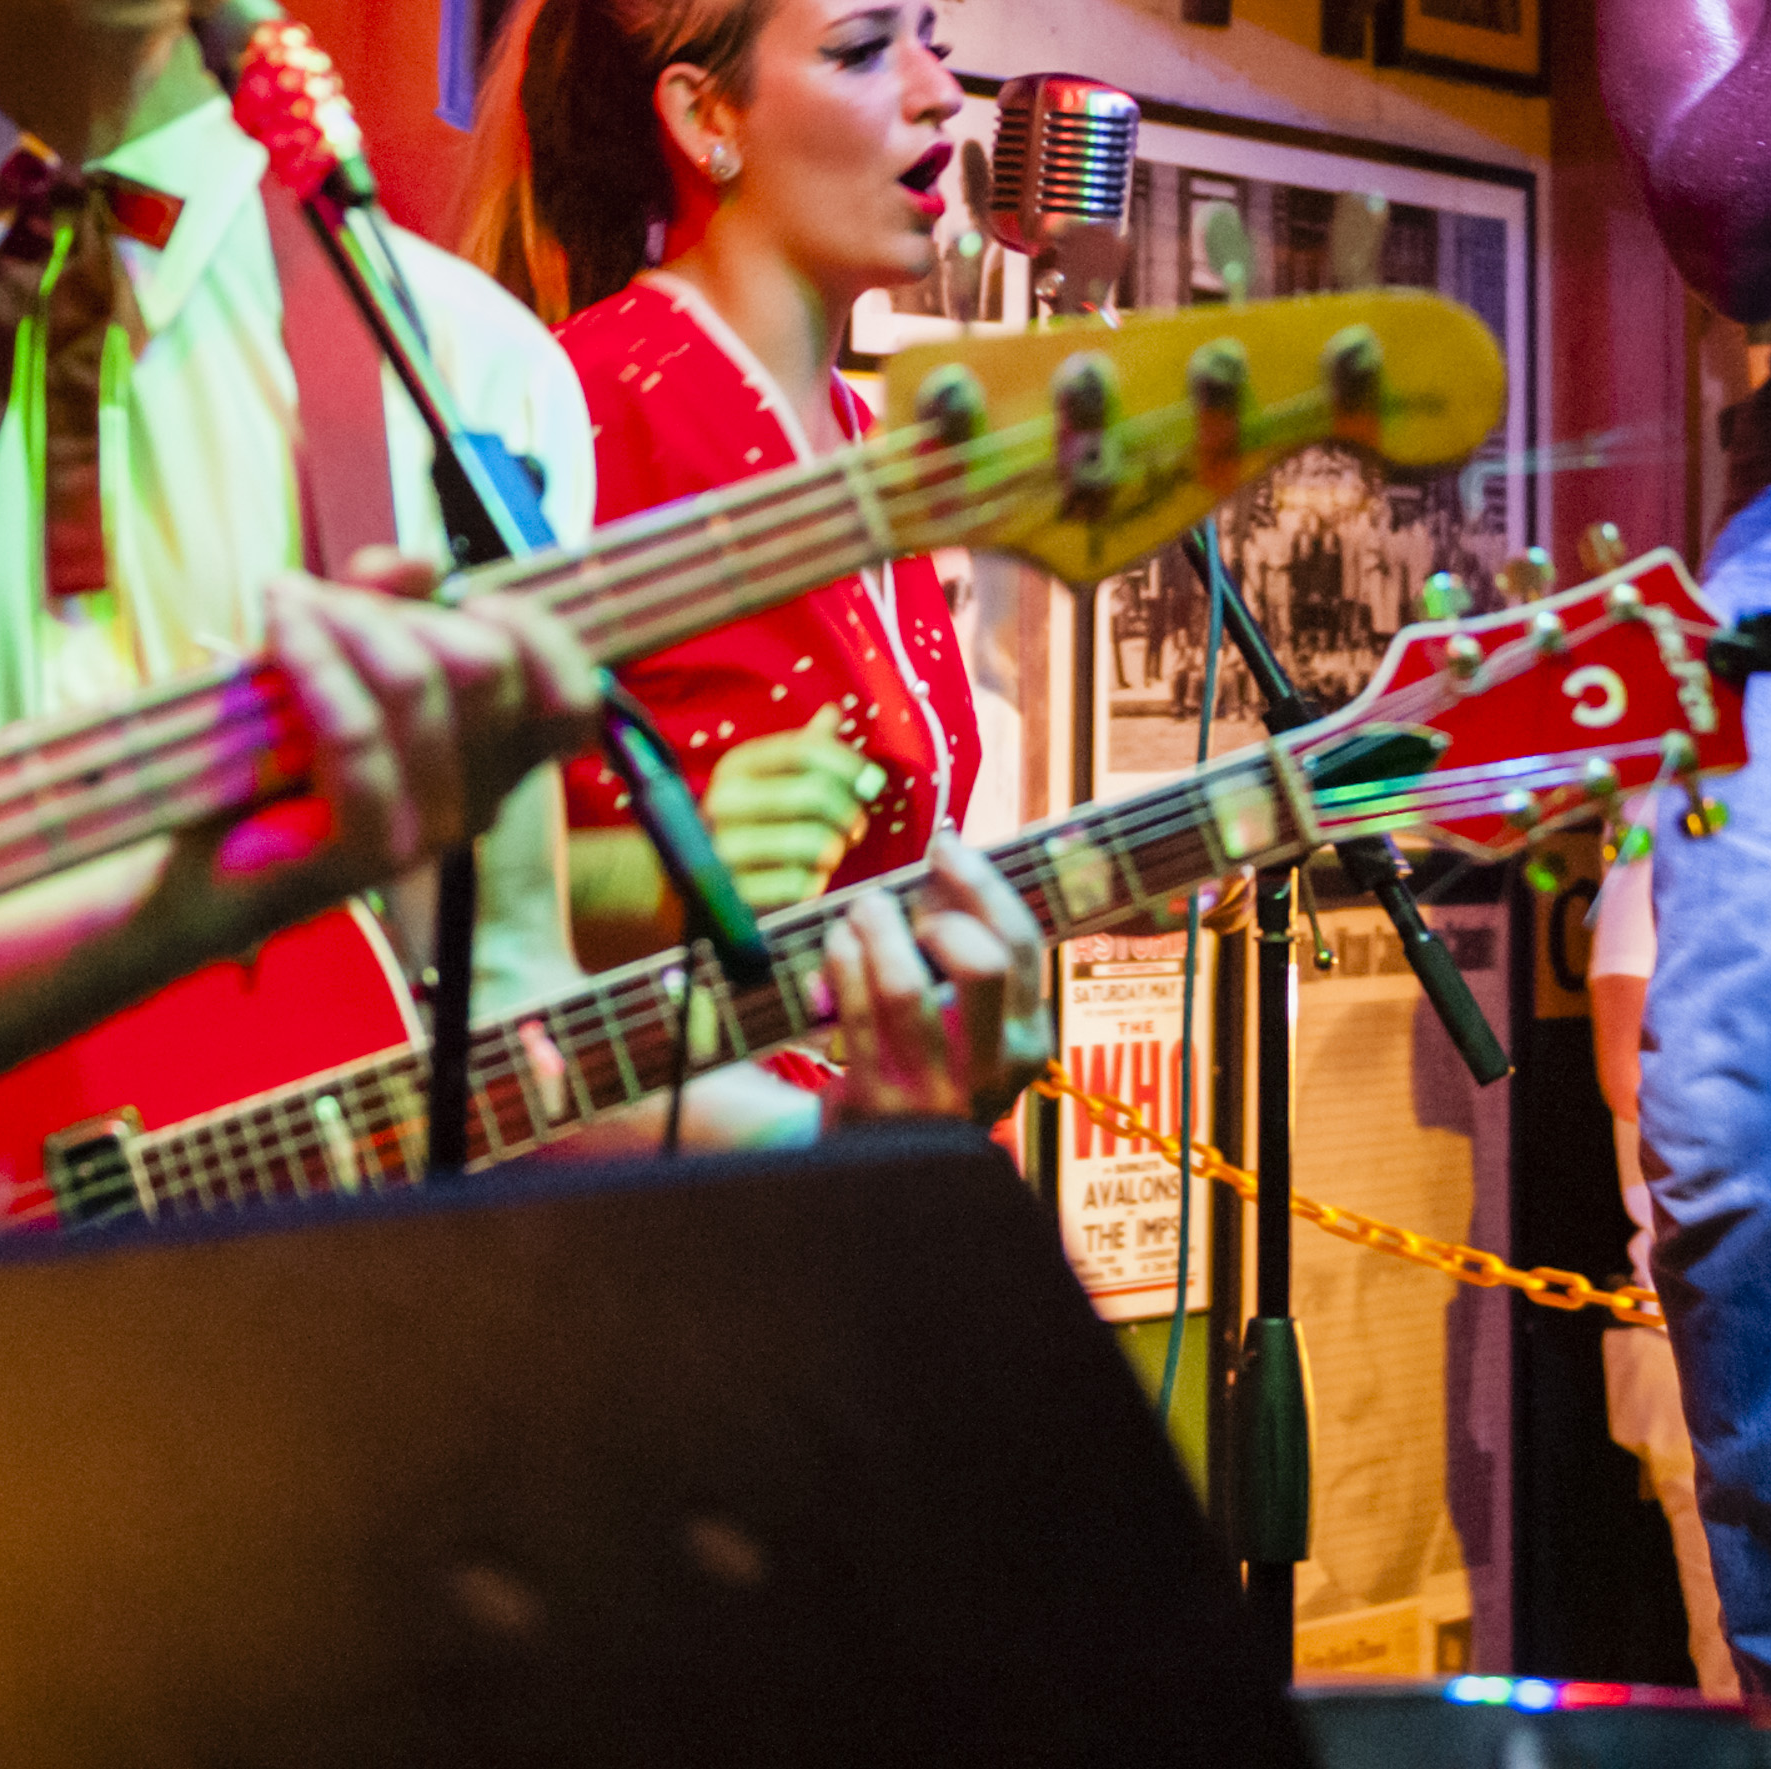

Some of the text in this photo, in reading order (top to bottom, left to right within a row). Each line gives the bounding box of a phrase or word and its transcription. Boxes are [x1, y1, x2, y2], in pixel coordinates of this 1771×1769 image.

[1073, 983, 1145, 1004] SATURDAY
[1117, 1019, 1155, 1035] THE
[1070, 1040, 1199, 1159] WHO
[1082, 1174, 1181, 1211] AVALONS
[1082, 1215, 1181, 1253] THE IMPS
